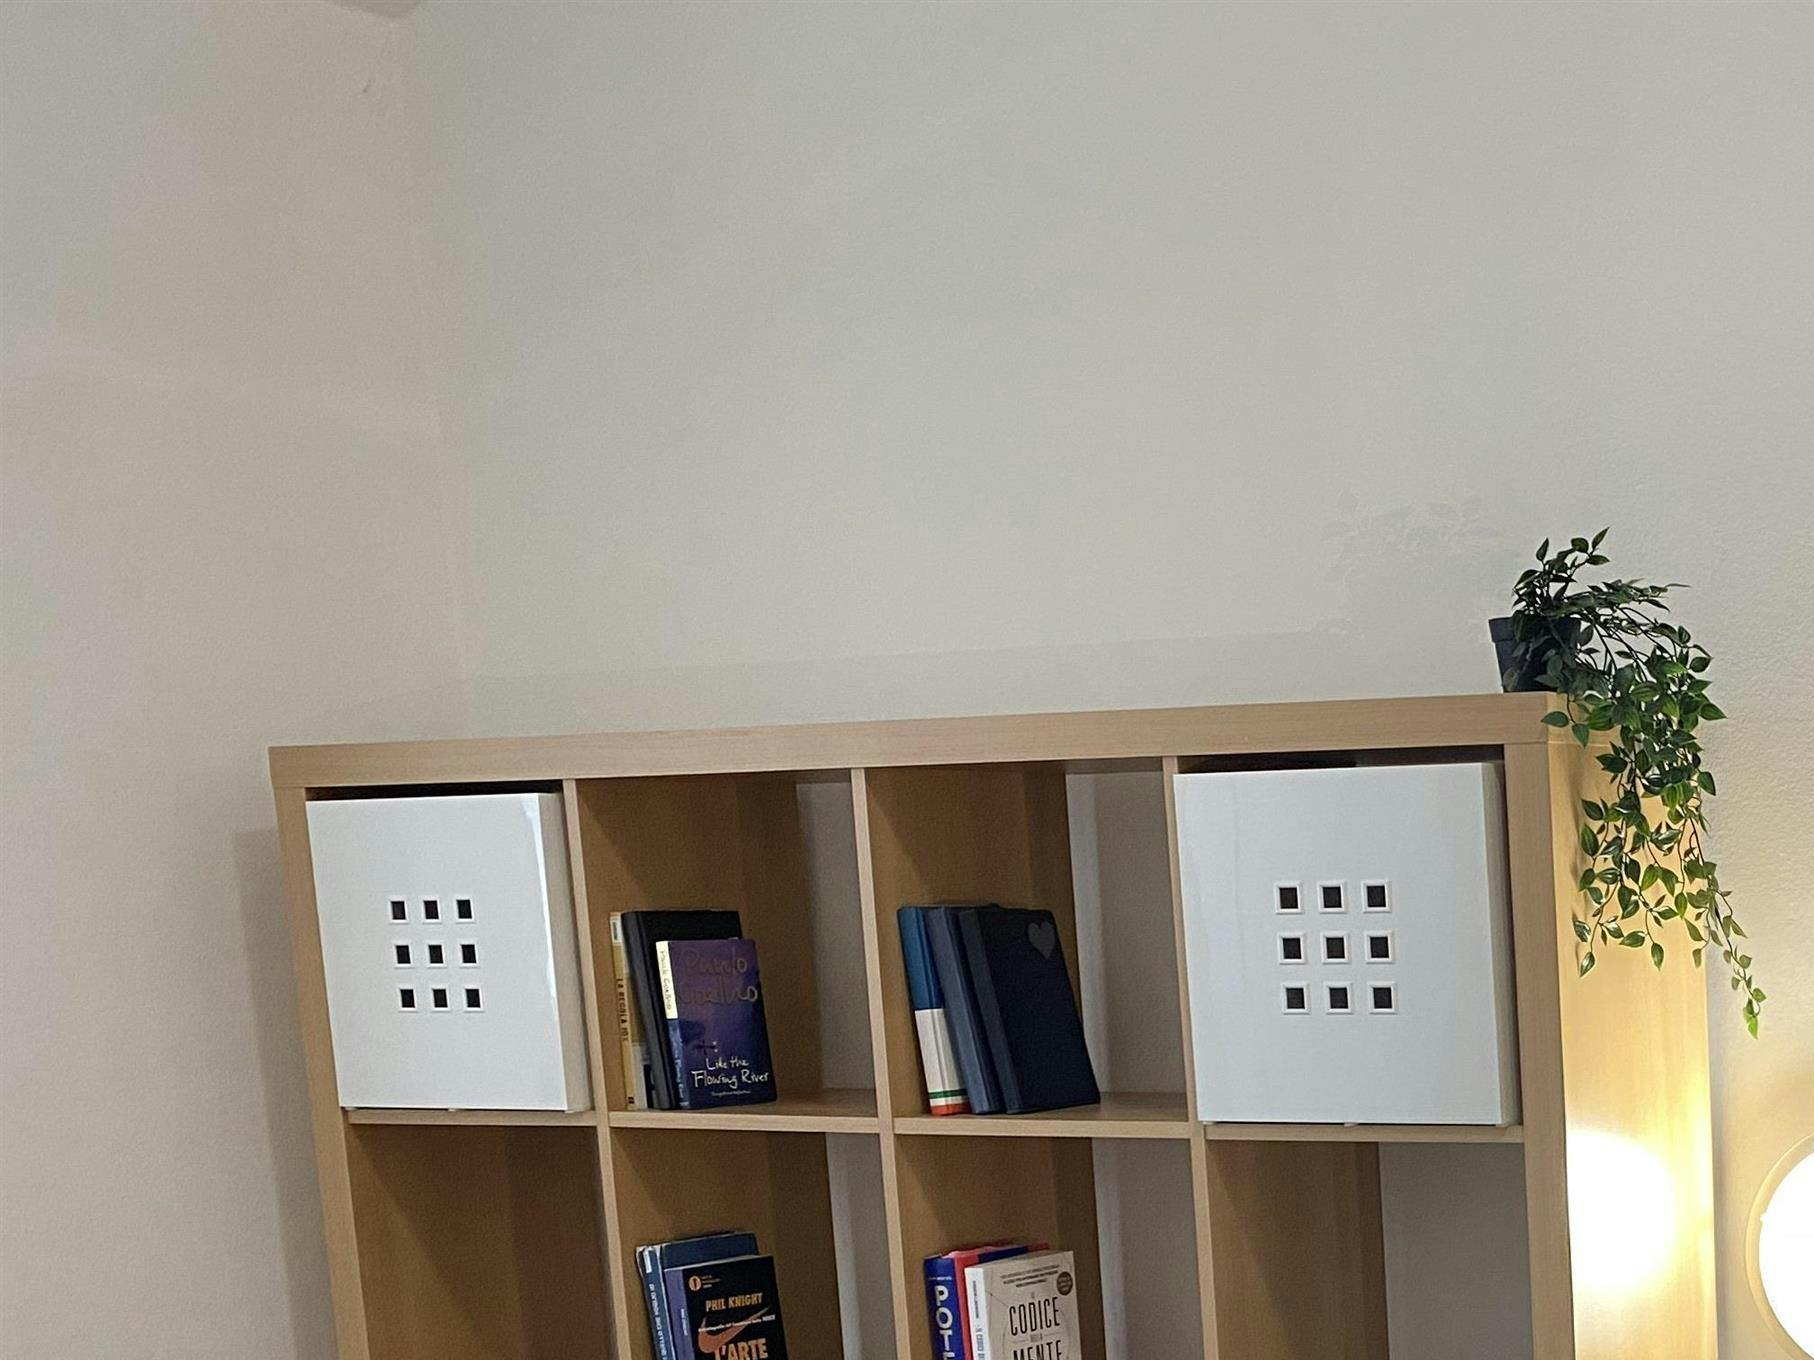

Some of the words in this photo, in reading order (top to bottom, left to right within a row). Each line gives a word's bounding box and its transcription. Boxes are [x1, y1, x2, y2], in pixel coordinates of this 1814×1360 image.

[705, 1057, 728, 1071] Like
[730, 1055, 750, 1067] the
[691, 1070, 738, 1089] Flowing
[741, 1068, 770, 1084] River
[705, 1297, 726, 1313] PHIL
[728, 1291, 763, 1309] KNIGHT
[1008, 1296, 1061, 1337] CODICE
